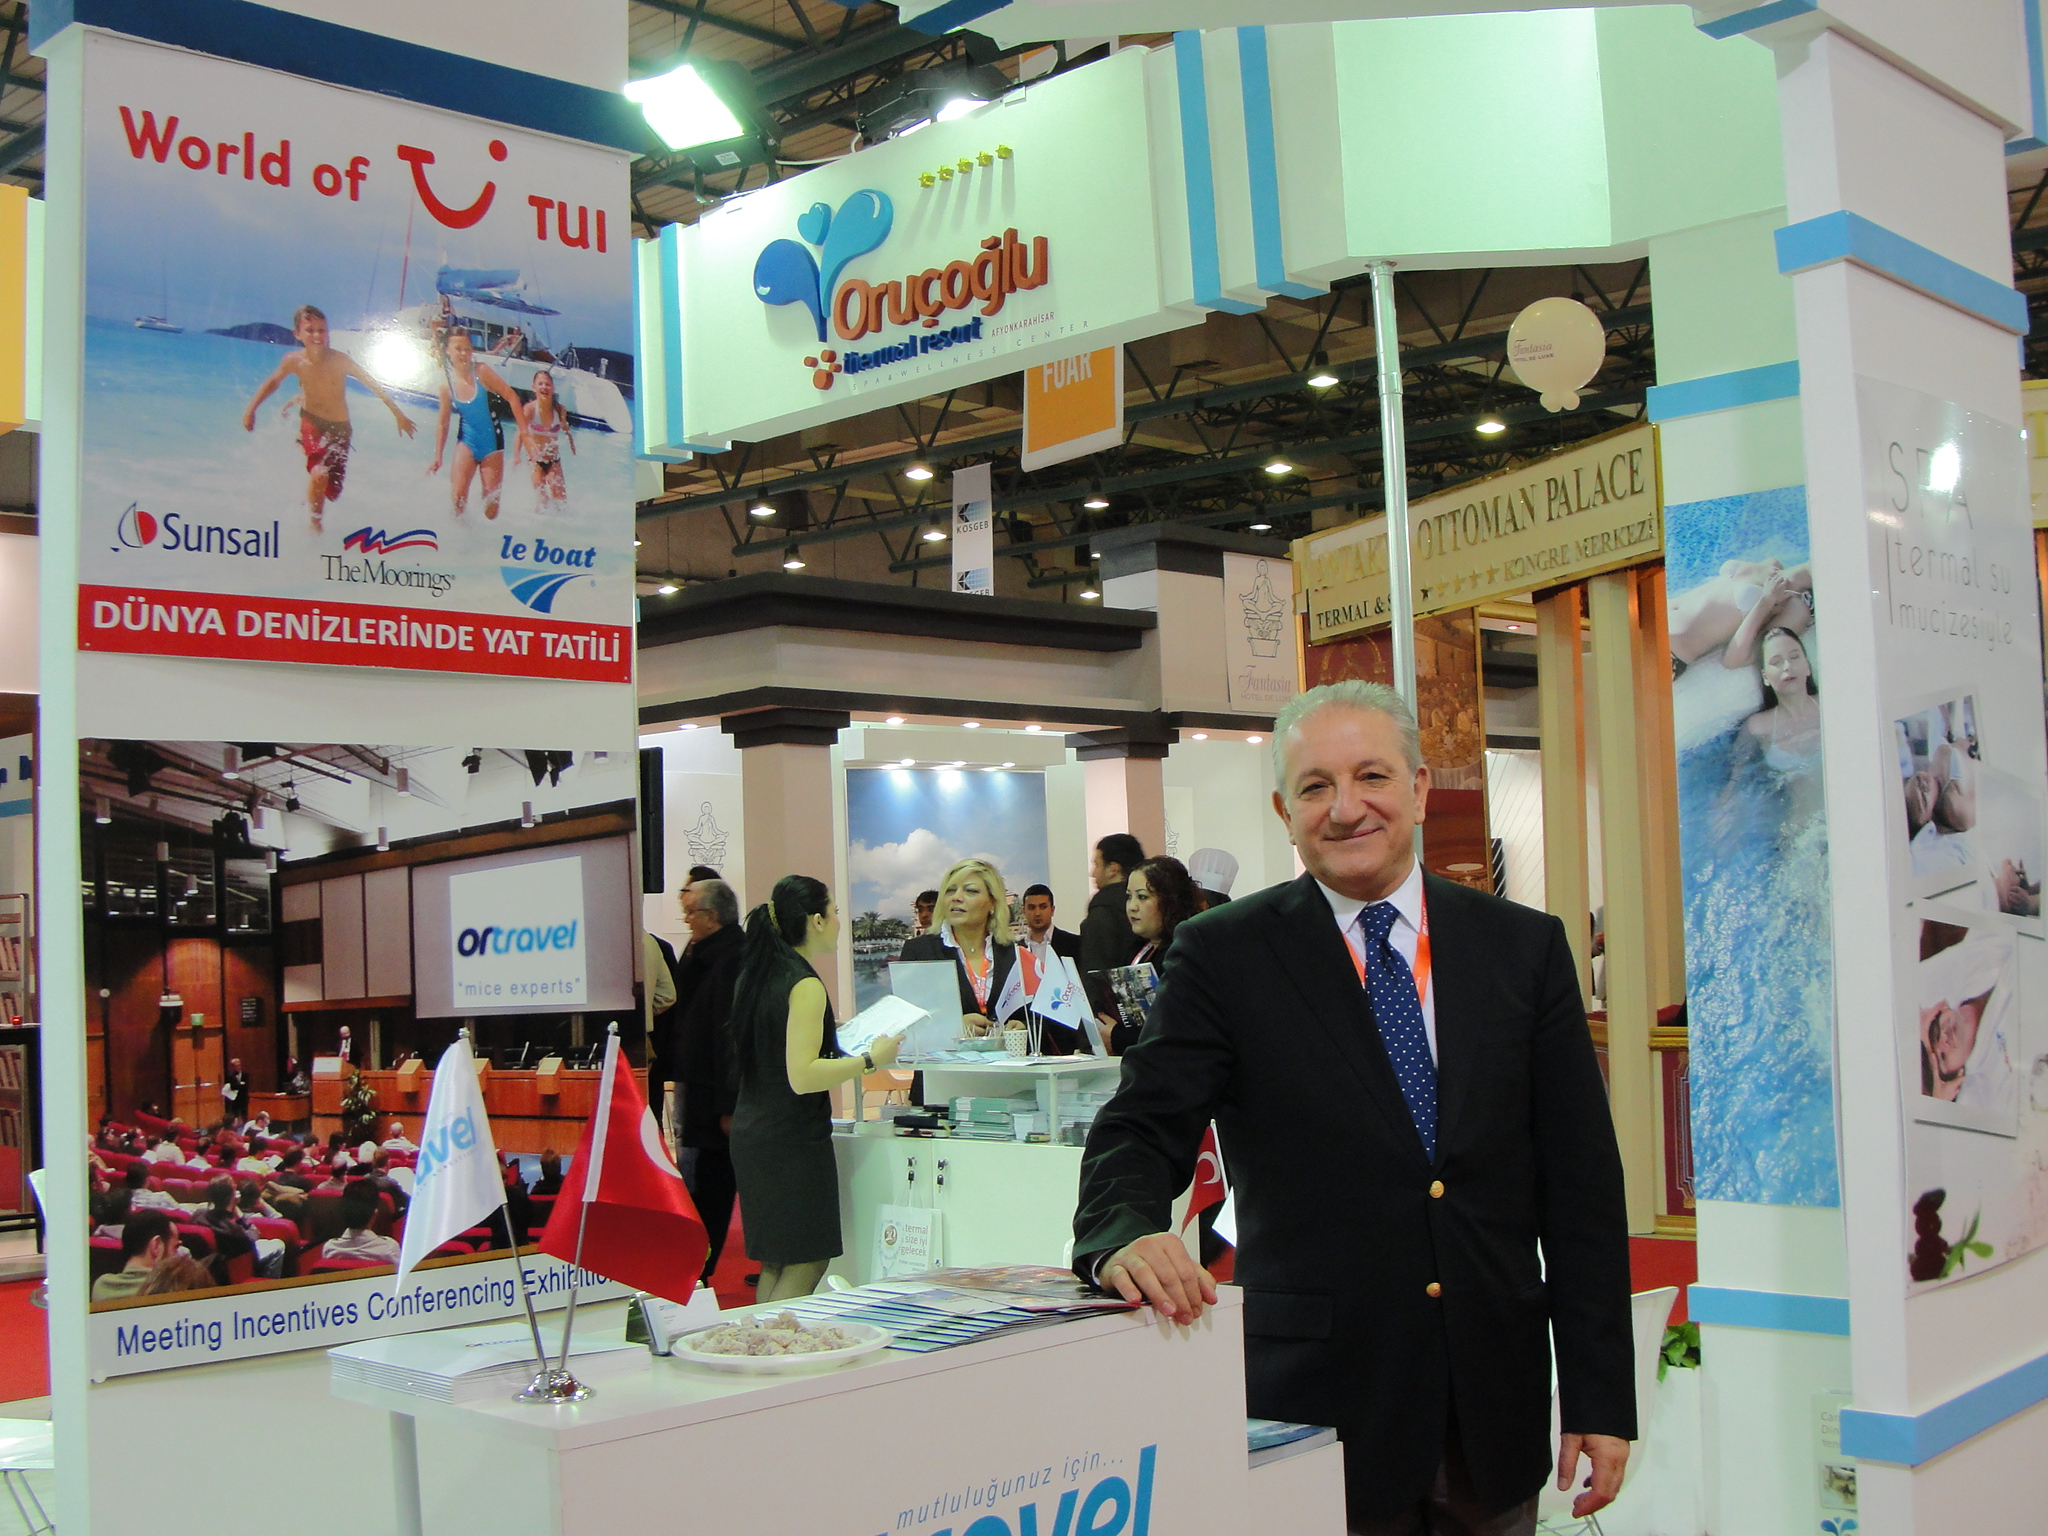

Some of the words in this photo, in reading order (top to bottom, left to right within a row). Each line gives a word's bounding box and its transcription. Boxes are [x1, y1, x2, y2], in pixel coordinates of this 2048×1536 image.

[119, 105, 290, 188] World
[312, 156, 371, 202] of
[528, 195, 607, 253] TUI
[833, 227, 1049, 341] Oruçoğlu
[901, 346, 997, 377] WELLNESS
[1017, 320, 1088, 347] CENTER
[920, 316, 983, 354] resort
[957, 521, 989, 534] KOSGEB
[1417, 483, 1538, 561] OTTOMAN
[1545, 447, 1645, 522] PALACE
[321, 555, 361, 584] The
[363, 558, 452, 598] Moorings
[501, 535, 526, 561] le
[534, 538, 597, 568] boat
[1316, 598, 1373, 631] TERMAL
[1503, 544, 1571, 581] KONGRE
[1575, 512, 1655, 563] MERKEZİ
[1895, 528, 1979, 589] termal
[1991, 563, 2011, 594] su
[93, 595, 226, 636] DÜNYA
[237, 608, 475, 652] DENİZLERİNDE
[482, 627, 534, 656] YAT
[540, 629, 620, 663] TATİLİ
[1900, 600, 2013, 652] mucizesiyle
[457, 919, 577, 957] ortravel
[117, 1318, 222, 1356] Meeting
[233, 1301, 358, 1340] Incentives
[368, 1277, 514, 1321] Conferencing
[523, 1263, 613, 1296] Exhibitio
[896, 1467, 1052, 1530] mutluluğunuz
[1063, 1452, 1123, 1482] için...
